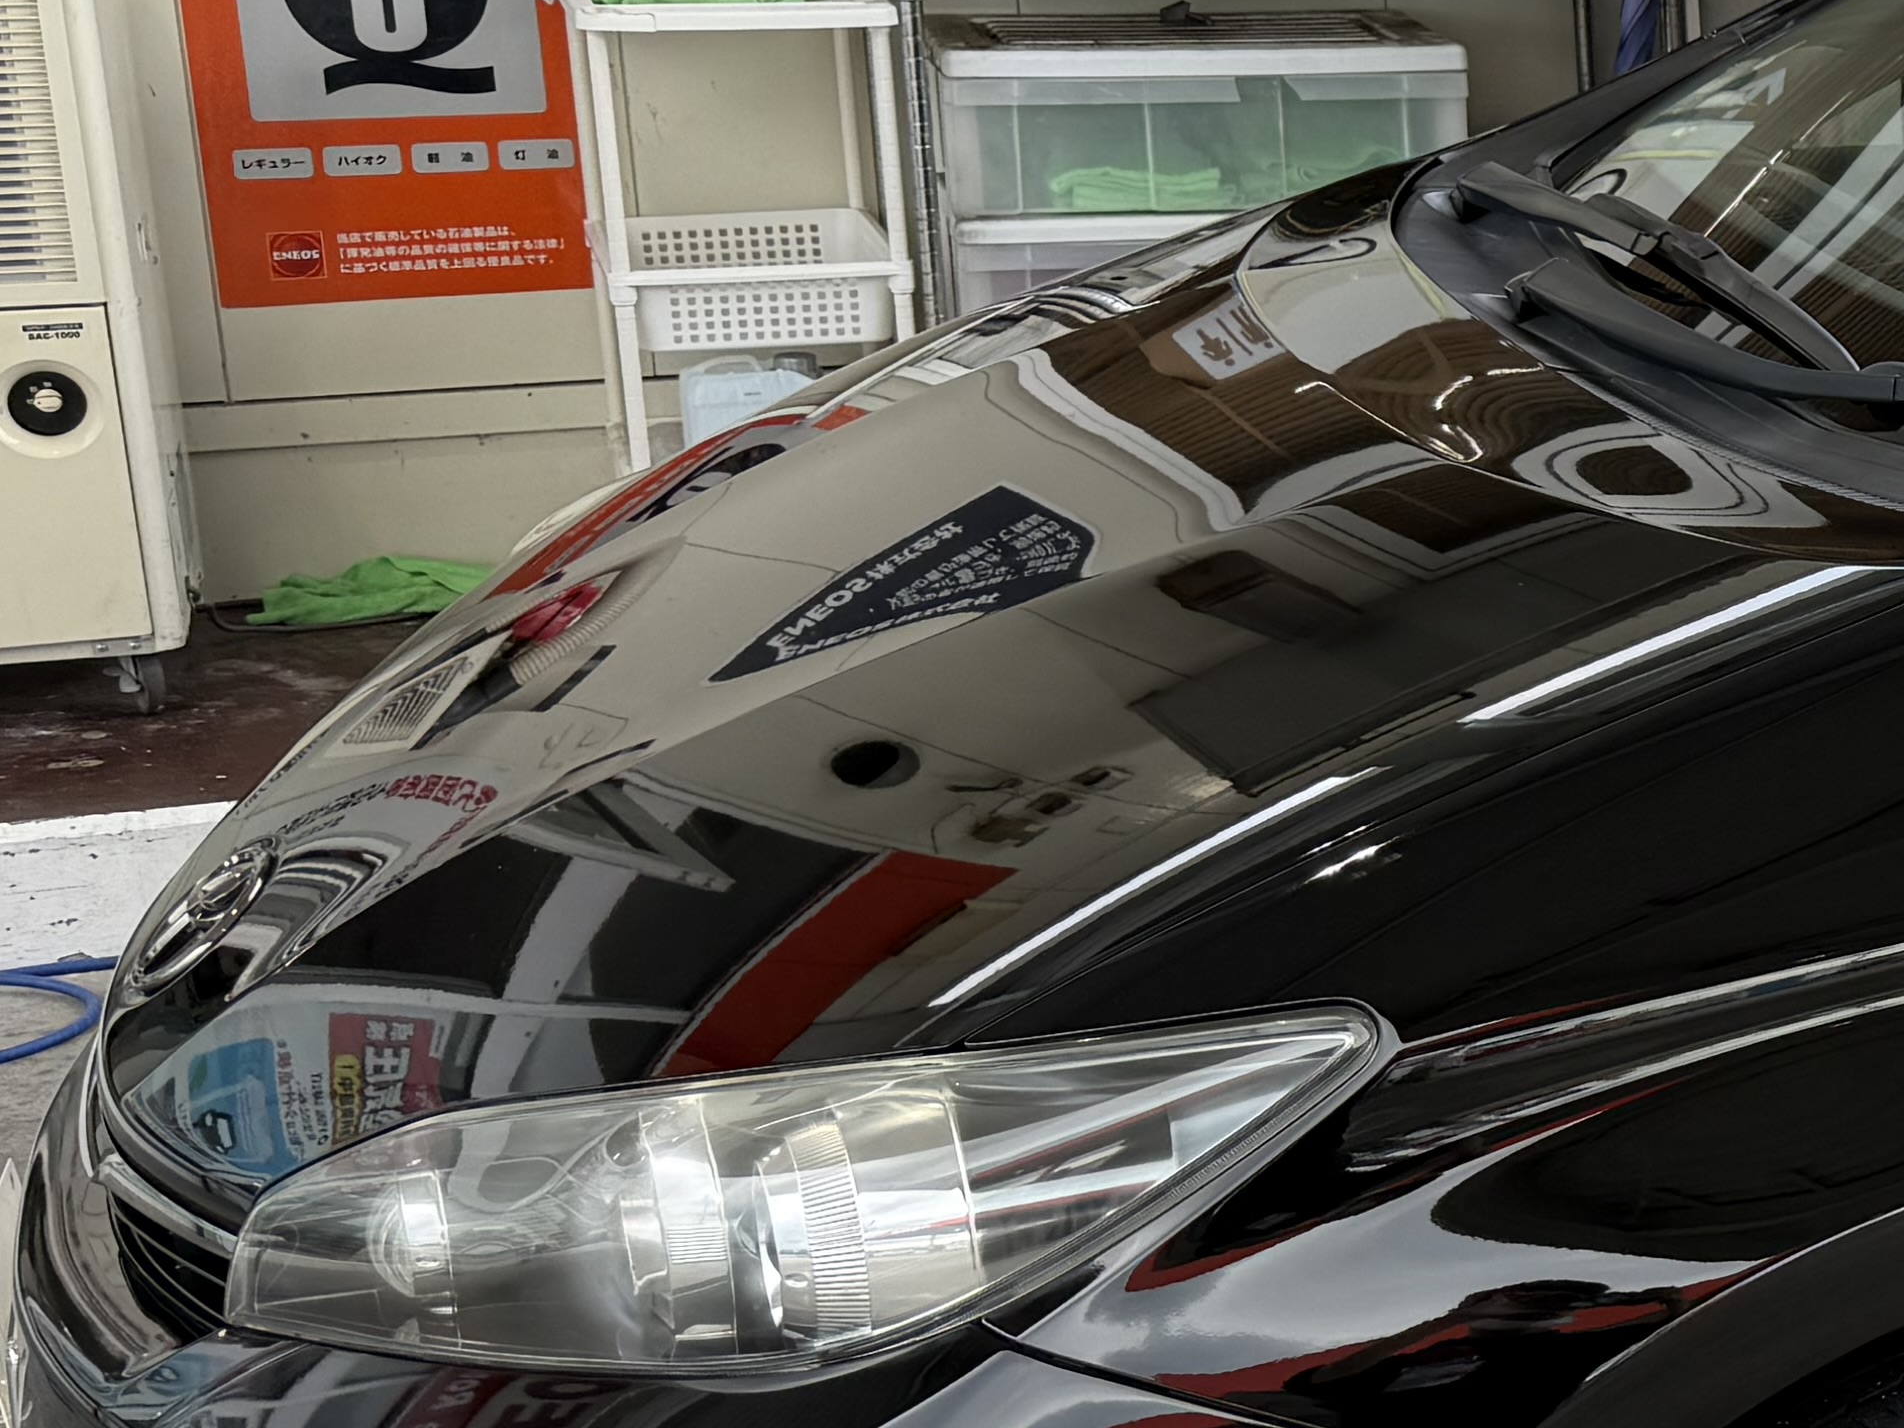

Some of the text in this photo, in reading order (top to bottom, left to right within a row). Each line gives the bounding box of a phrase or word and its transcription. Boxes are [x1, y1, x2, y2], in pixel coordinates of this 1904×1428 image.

[241, 157, 306, 170] レギュラー
[338, 154, 388, 167] ハイオク
